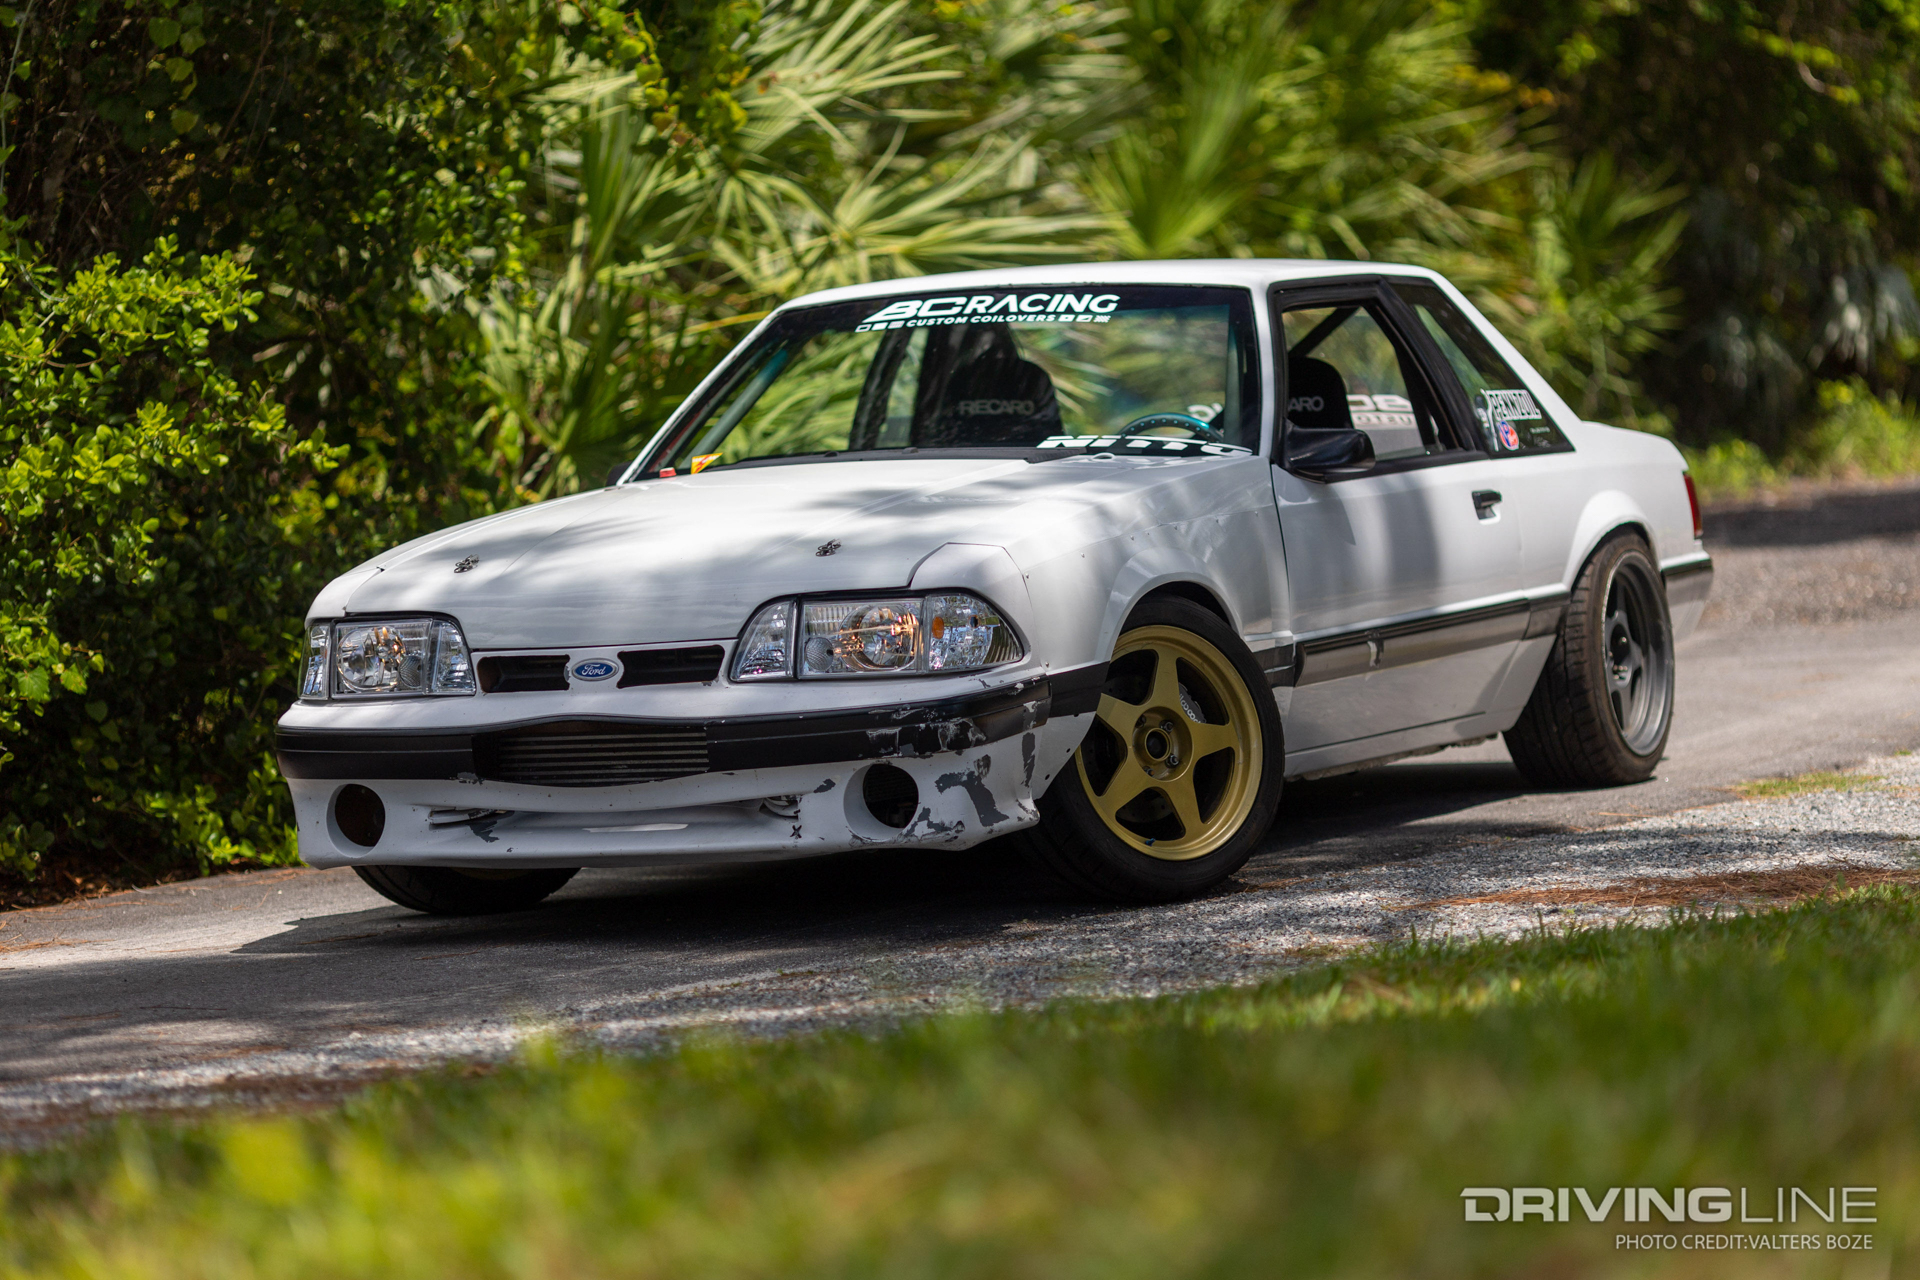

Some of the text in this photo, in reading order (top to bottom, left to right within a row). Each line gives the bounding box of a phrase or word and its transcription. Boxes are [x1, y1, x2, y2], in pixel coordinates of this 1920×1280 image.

[906, 314, 1056, 328] CUSTOM COILOVERS
[959, 399, 1034, 415] RECARO
[1287, 396, 1324, 411] ARO
[1486, 389, 1542, 421] PENNZOIL
[581, 663, 607, 676] Ford
